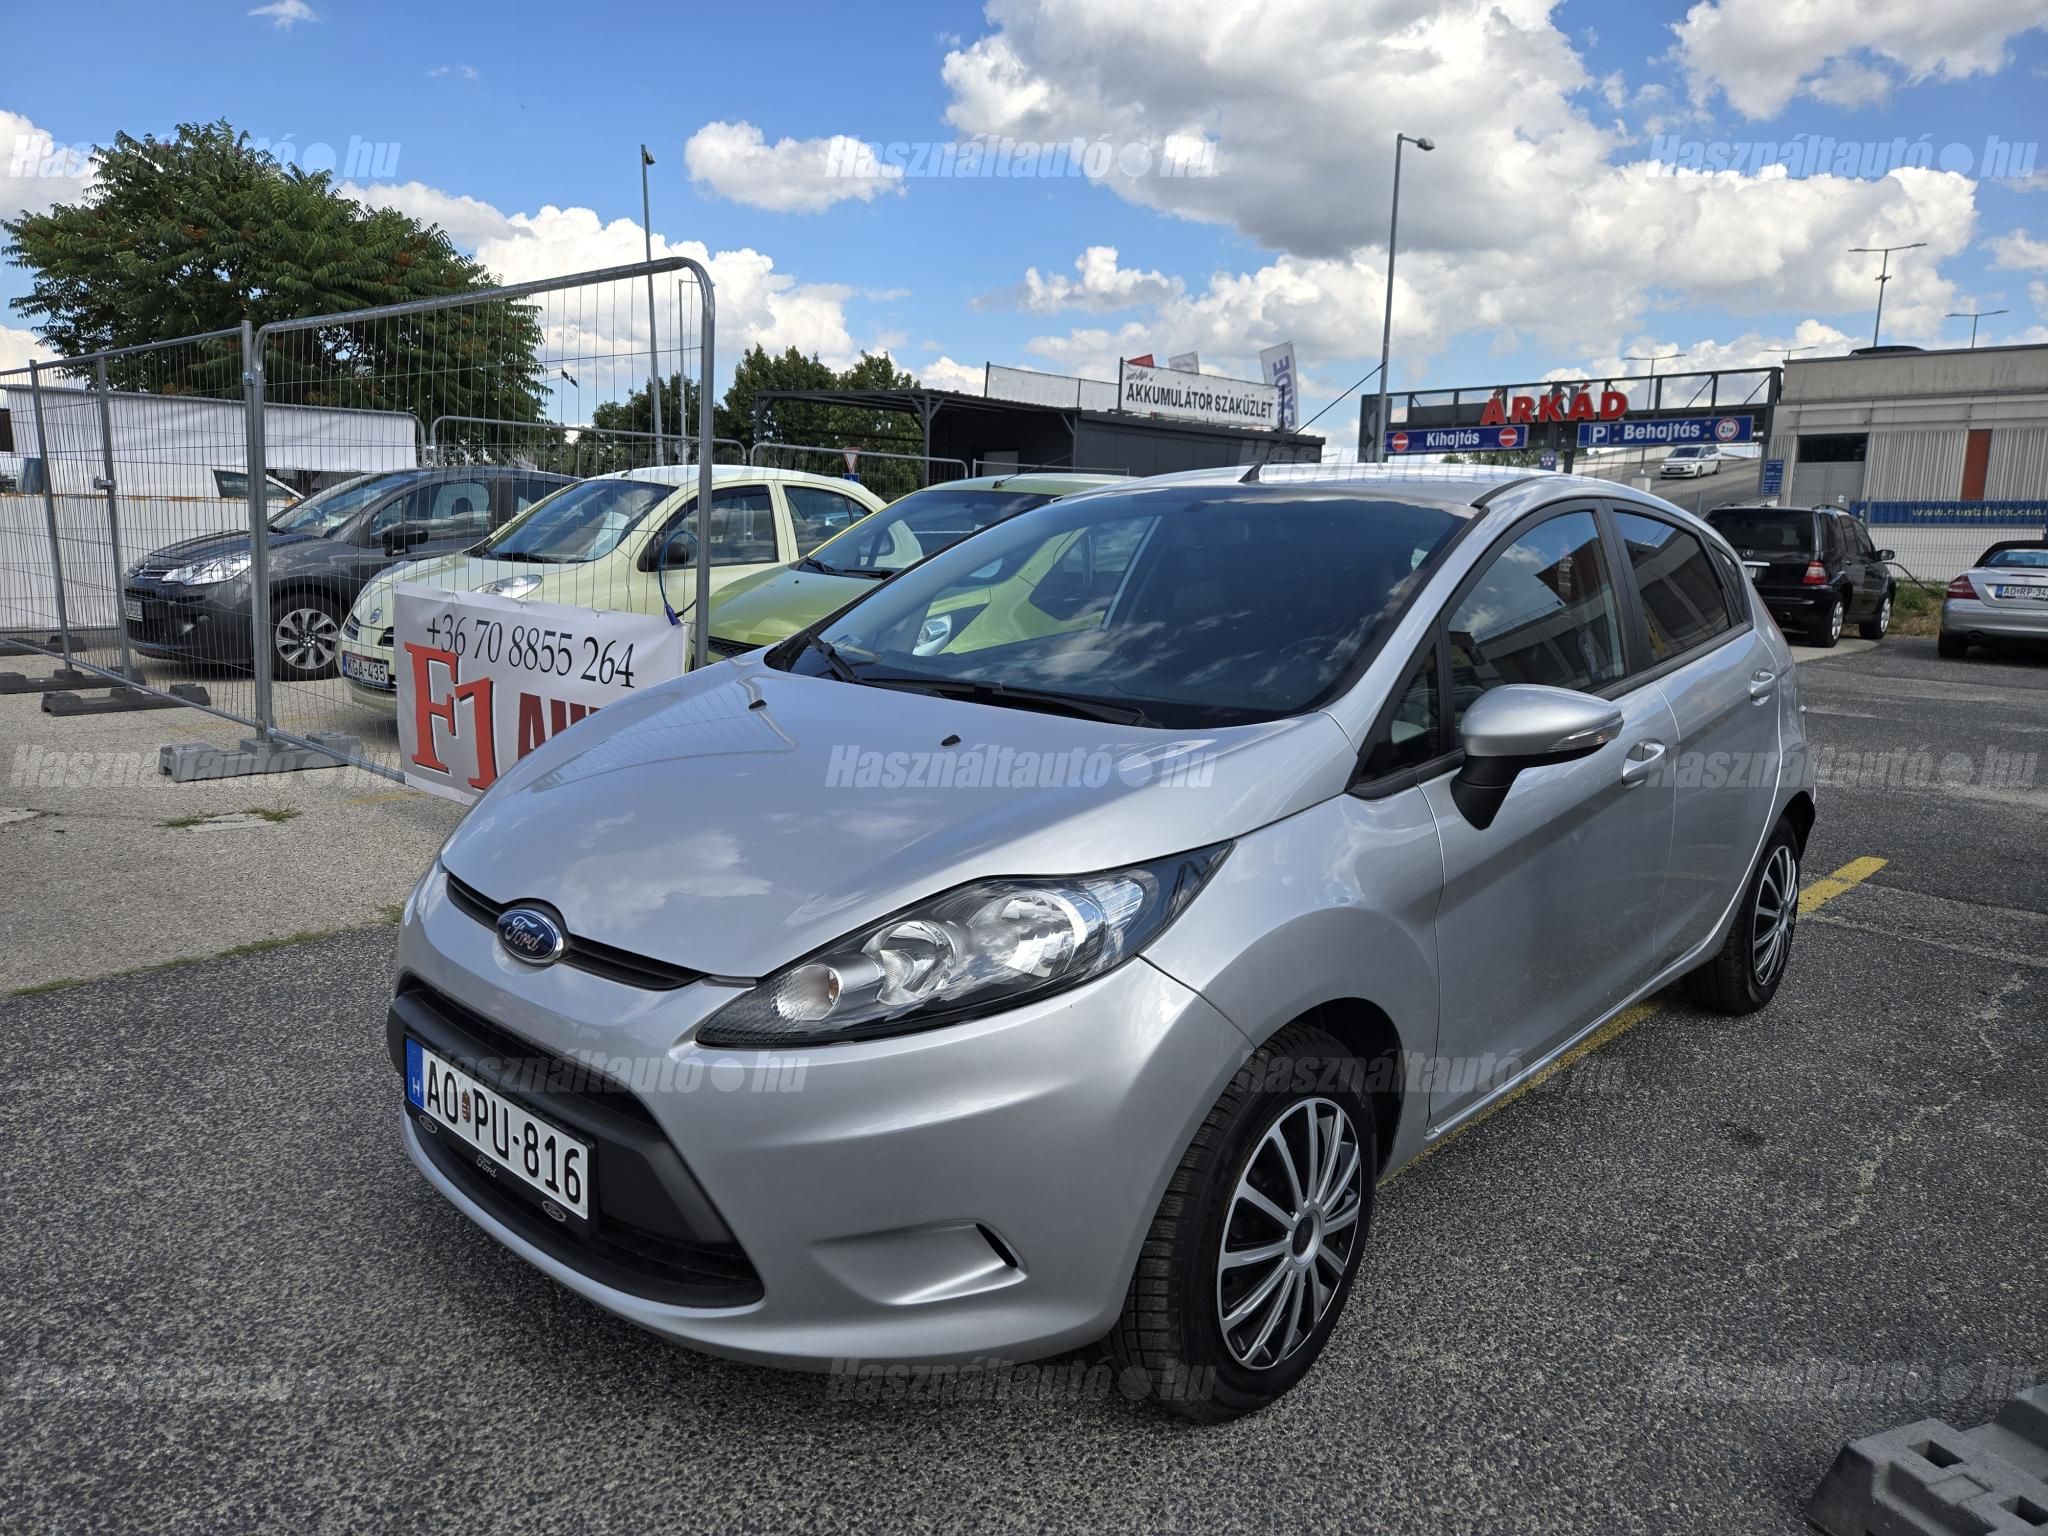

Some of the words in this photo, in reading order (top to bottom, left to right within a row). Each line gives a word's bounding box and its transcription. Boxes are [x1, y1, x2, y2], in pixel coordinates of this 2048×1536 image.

[1126, 383, 1212, 411] AKKUMULÁTOR
[1214, 393, 1274, 419] SZAKÜZLET
[1479, 383, 1629, 426] ÁRKÁD
[1426, 430, 1480, 449] Kihajtás
[1592, 426, 1606, 443] P
[1623, 421, 1700, 442] Behajtás
[2020, 587, 2048, 598] RP-34
[426, 613, 467, 657] +36
[474, 619, 503, 664] 70
[508, 625, 573, 677] 8855
[580, 636, 636, 689] 264
[404, 641, 499, 791] F1
[504, 916, 545, 952] Ford
[427, 1060, 459, 1125] AO
[473, 1088, 581, 1205] PU-816
